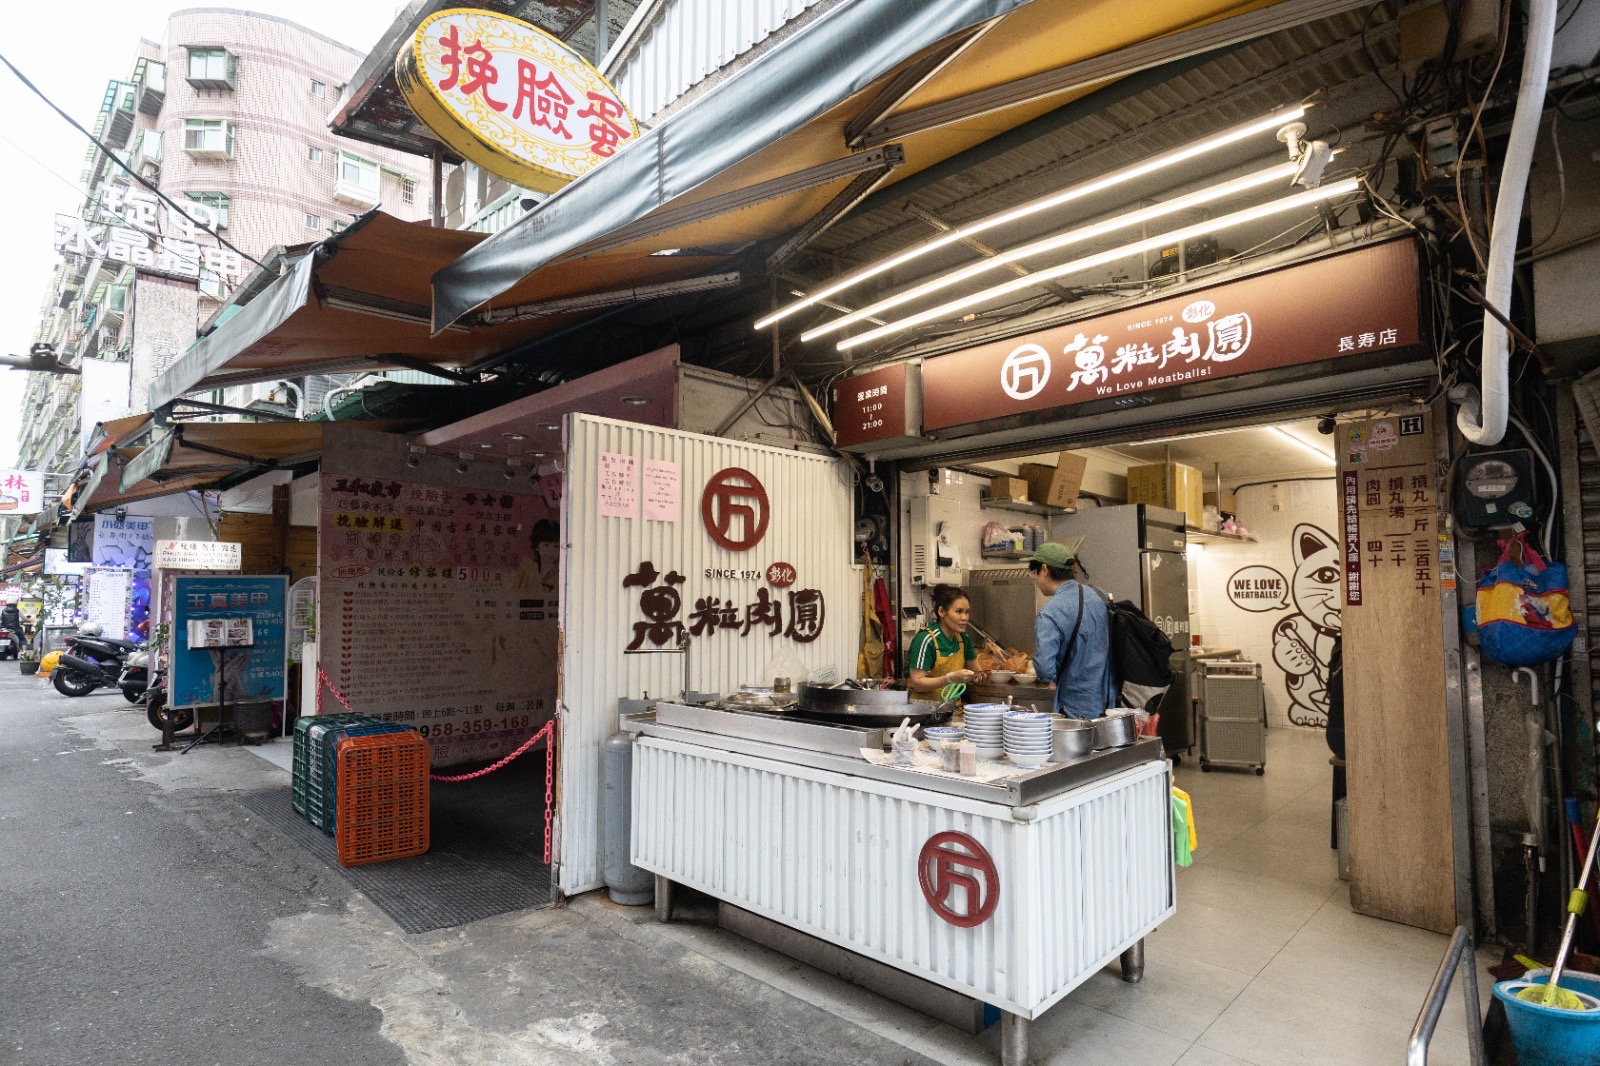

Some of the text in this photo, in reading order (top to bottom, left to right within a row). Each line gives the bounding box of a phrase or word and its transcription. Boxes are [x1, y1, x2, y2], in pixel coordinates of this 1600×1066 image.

[438, 24, 631, 158] 挽臉蛋
[55, 216, 242, 277] 水晶指甲
[1186, 304, 1212, 319] 彰化
[1127, 315, 1173, 331] SINCE 1974
[1064, 312, 1252, 391] 萬粒肉圓
[1096, 367, 1211, 395] We Love Meatballs!
[862, 403, 882, 413] 11:00
[862, 419, 883, 430] 21:00
[331, 478, 402, 499] 三和夜市
[410, 488, 453, 504] 挽臉蛋
[1367, 541, 1383, 568] 四十
[1390, 540, 1406, 567] 三十
[705, 569, 761, 580] SINCE 1974
[769, 568, 793, 584] 彰化
[1414, 539, 1432, 596] 三百五十
[1234, 578, 1282, 590] WE LOVE
[187, 592, 269, 610] 玉真美甲
[1234, 591, 1282, 599] MEATBALLS!
[622, 561, 825, 650] 萬粒肉圓
[411, 715, 529, 739] 958-359-168
